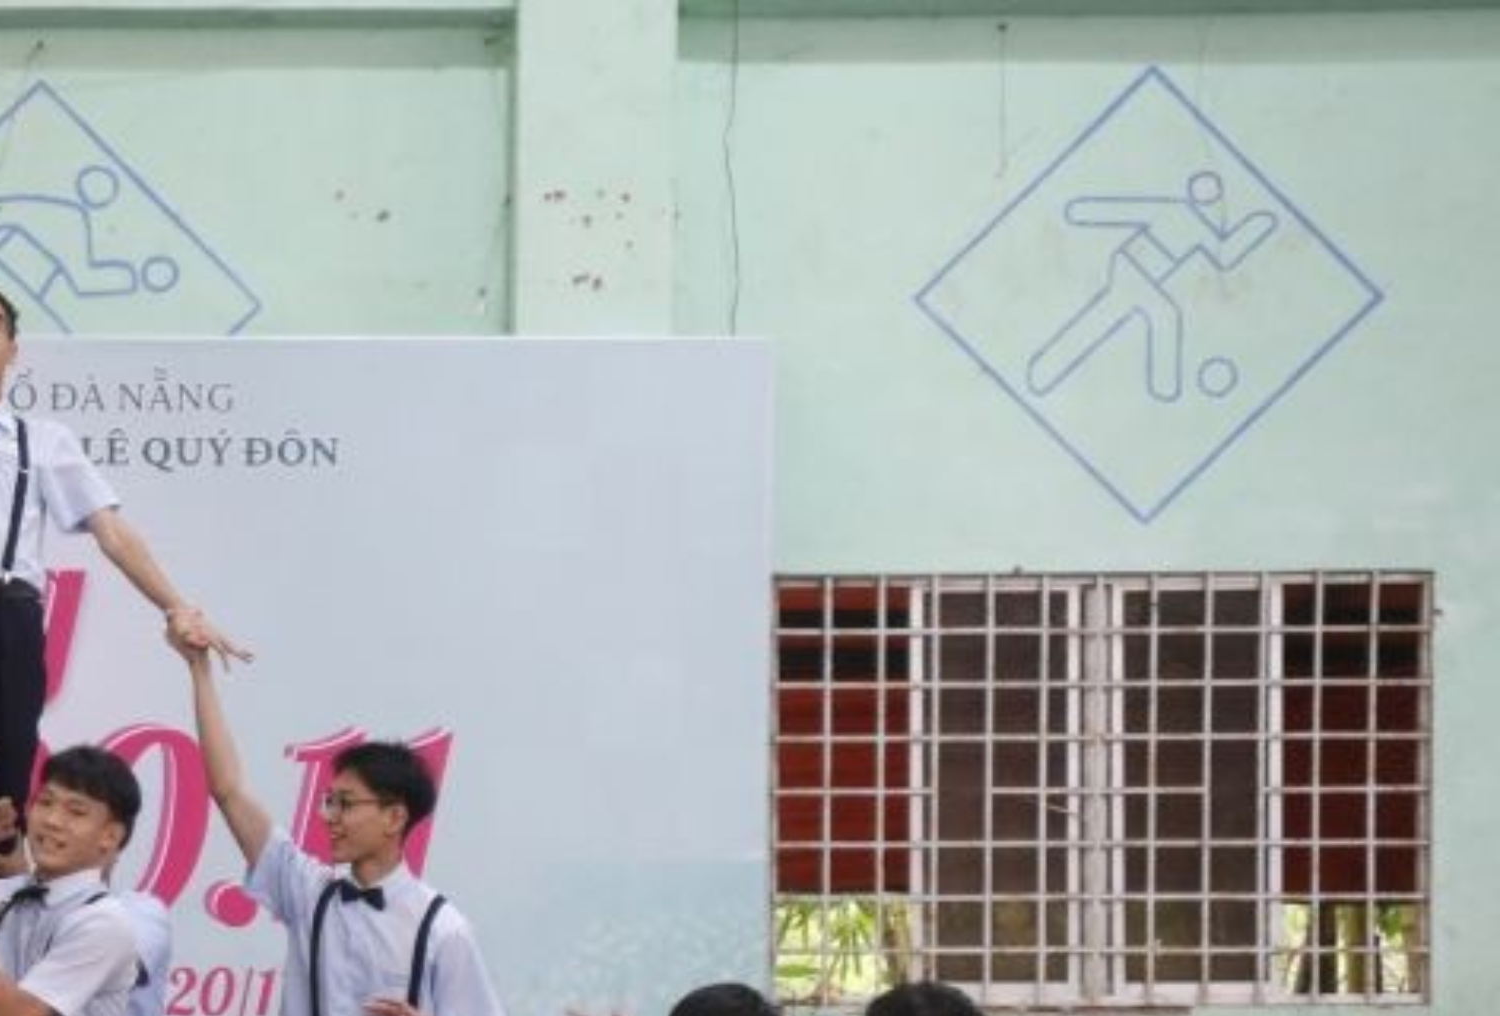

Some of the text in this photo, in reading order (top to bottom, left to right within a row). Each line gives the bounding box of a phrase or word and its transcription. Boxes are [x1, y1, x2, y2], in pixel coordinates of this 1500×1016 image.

[50, 376, 105, 413] ĐÀ
[118, 367, 234, 413] NẴNG
[81, 427, 130, 467] LÊ
[141, 428, 233, 472] QUÝ
[244, 428, 341, 467] ĐÔN
